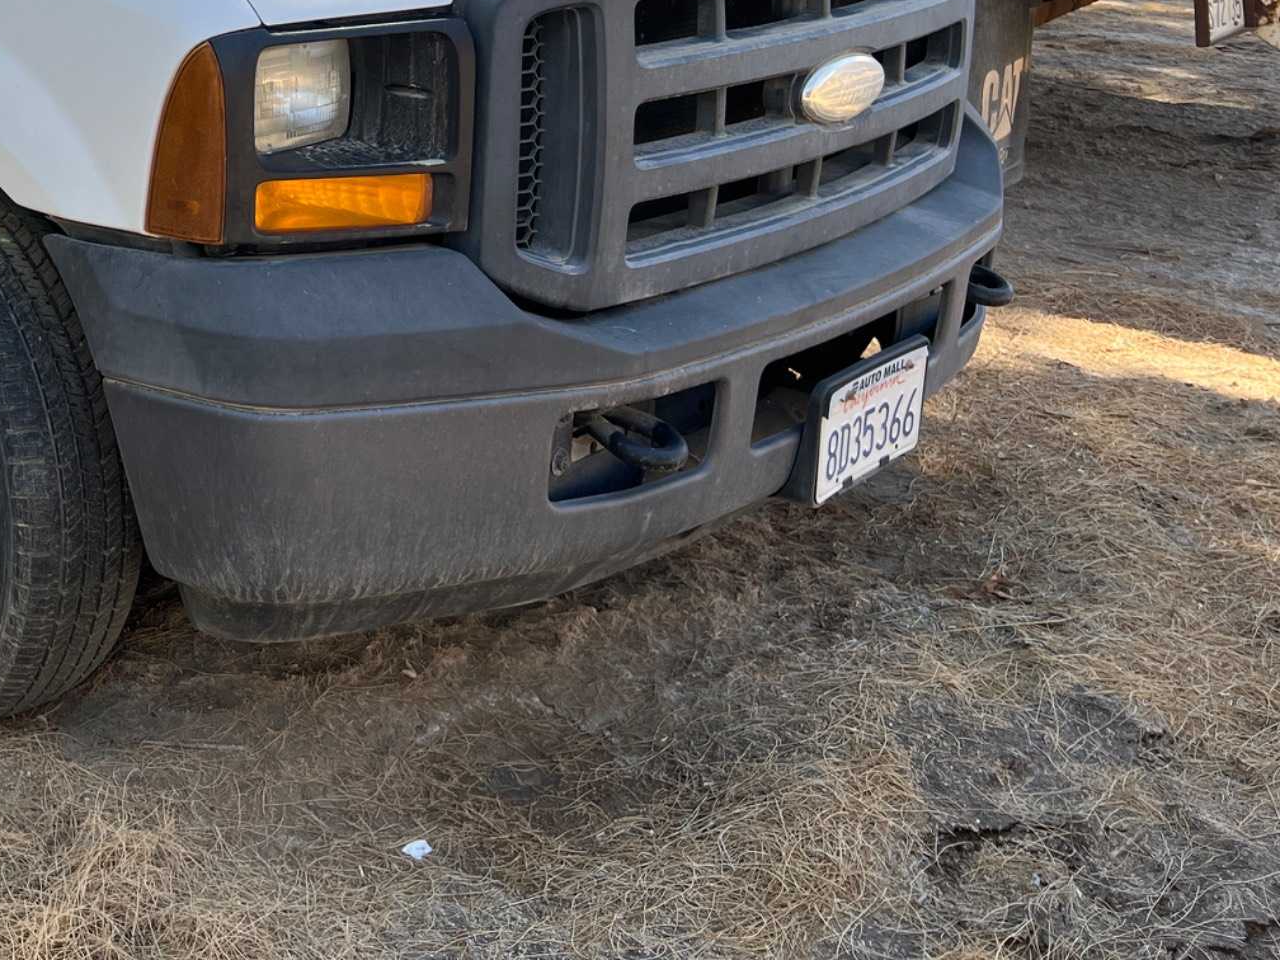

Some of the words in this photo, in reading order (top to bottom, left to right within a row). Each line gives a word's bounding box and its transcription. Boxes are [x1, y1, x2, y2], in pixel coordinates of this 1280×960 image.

[981, 56, 1024, 134] CAT
[860, 371, 882, 392] AUTO
[883, 359, 907, 379] MALL
[826, 387, 918, 481] 8D35366
